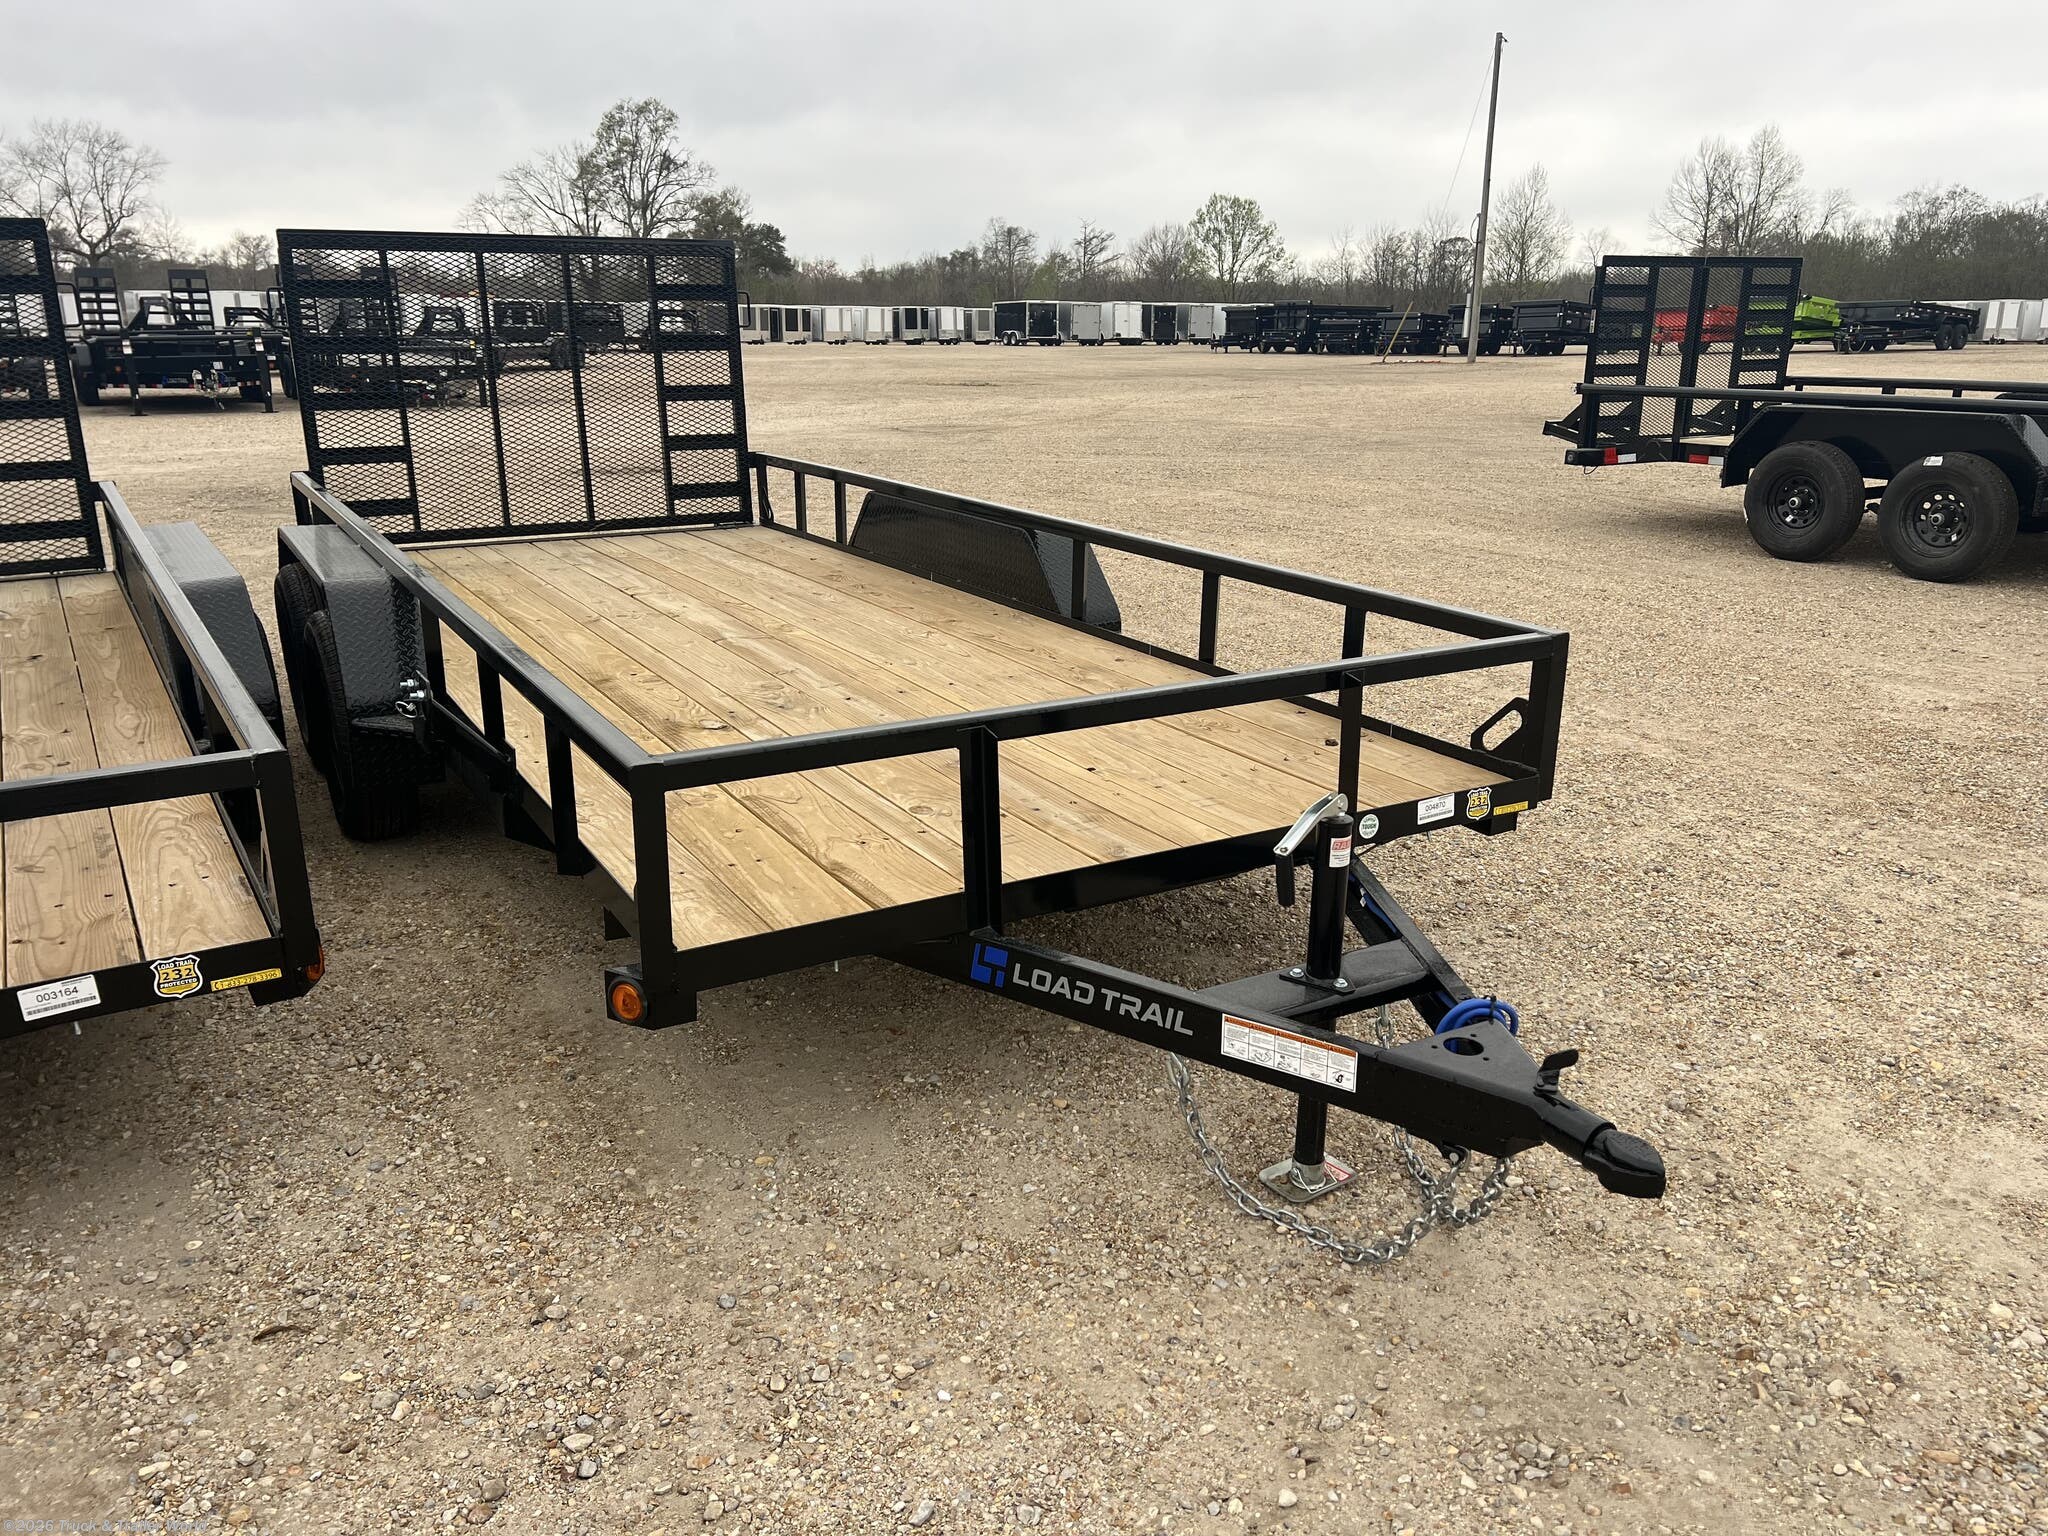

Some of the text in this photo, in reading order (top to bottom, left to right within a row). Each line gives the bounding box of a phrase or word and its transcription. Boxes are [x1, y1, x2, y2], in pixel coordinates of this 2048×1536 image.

[1471, 796, 1487, 807] 232
[157, 959, 195, 971] LOAD TRAIL
[161, 967, 193, 981] 232
[160, 978, 197, 989] PROTECTED
[36, 986, 78, 1003] 003164
[1012, 963, 1095, 1005] LOAD
[1101, 988, 1194, 1037] TRAIL
